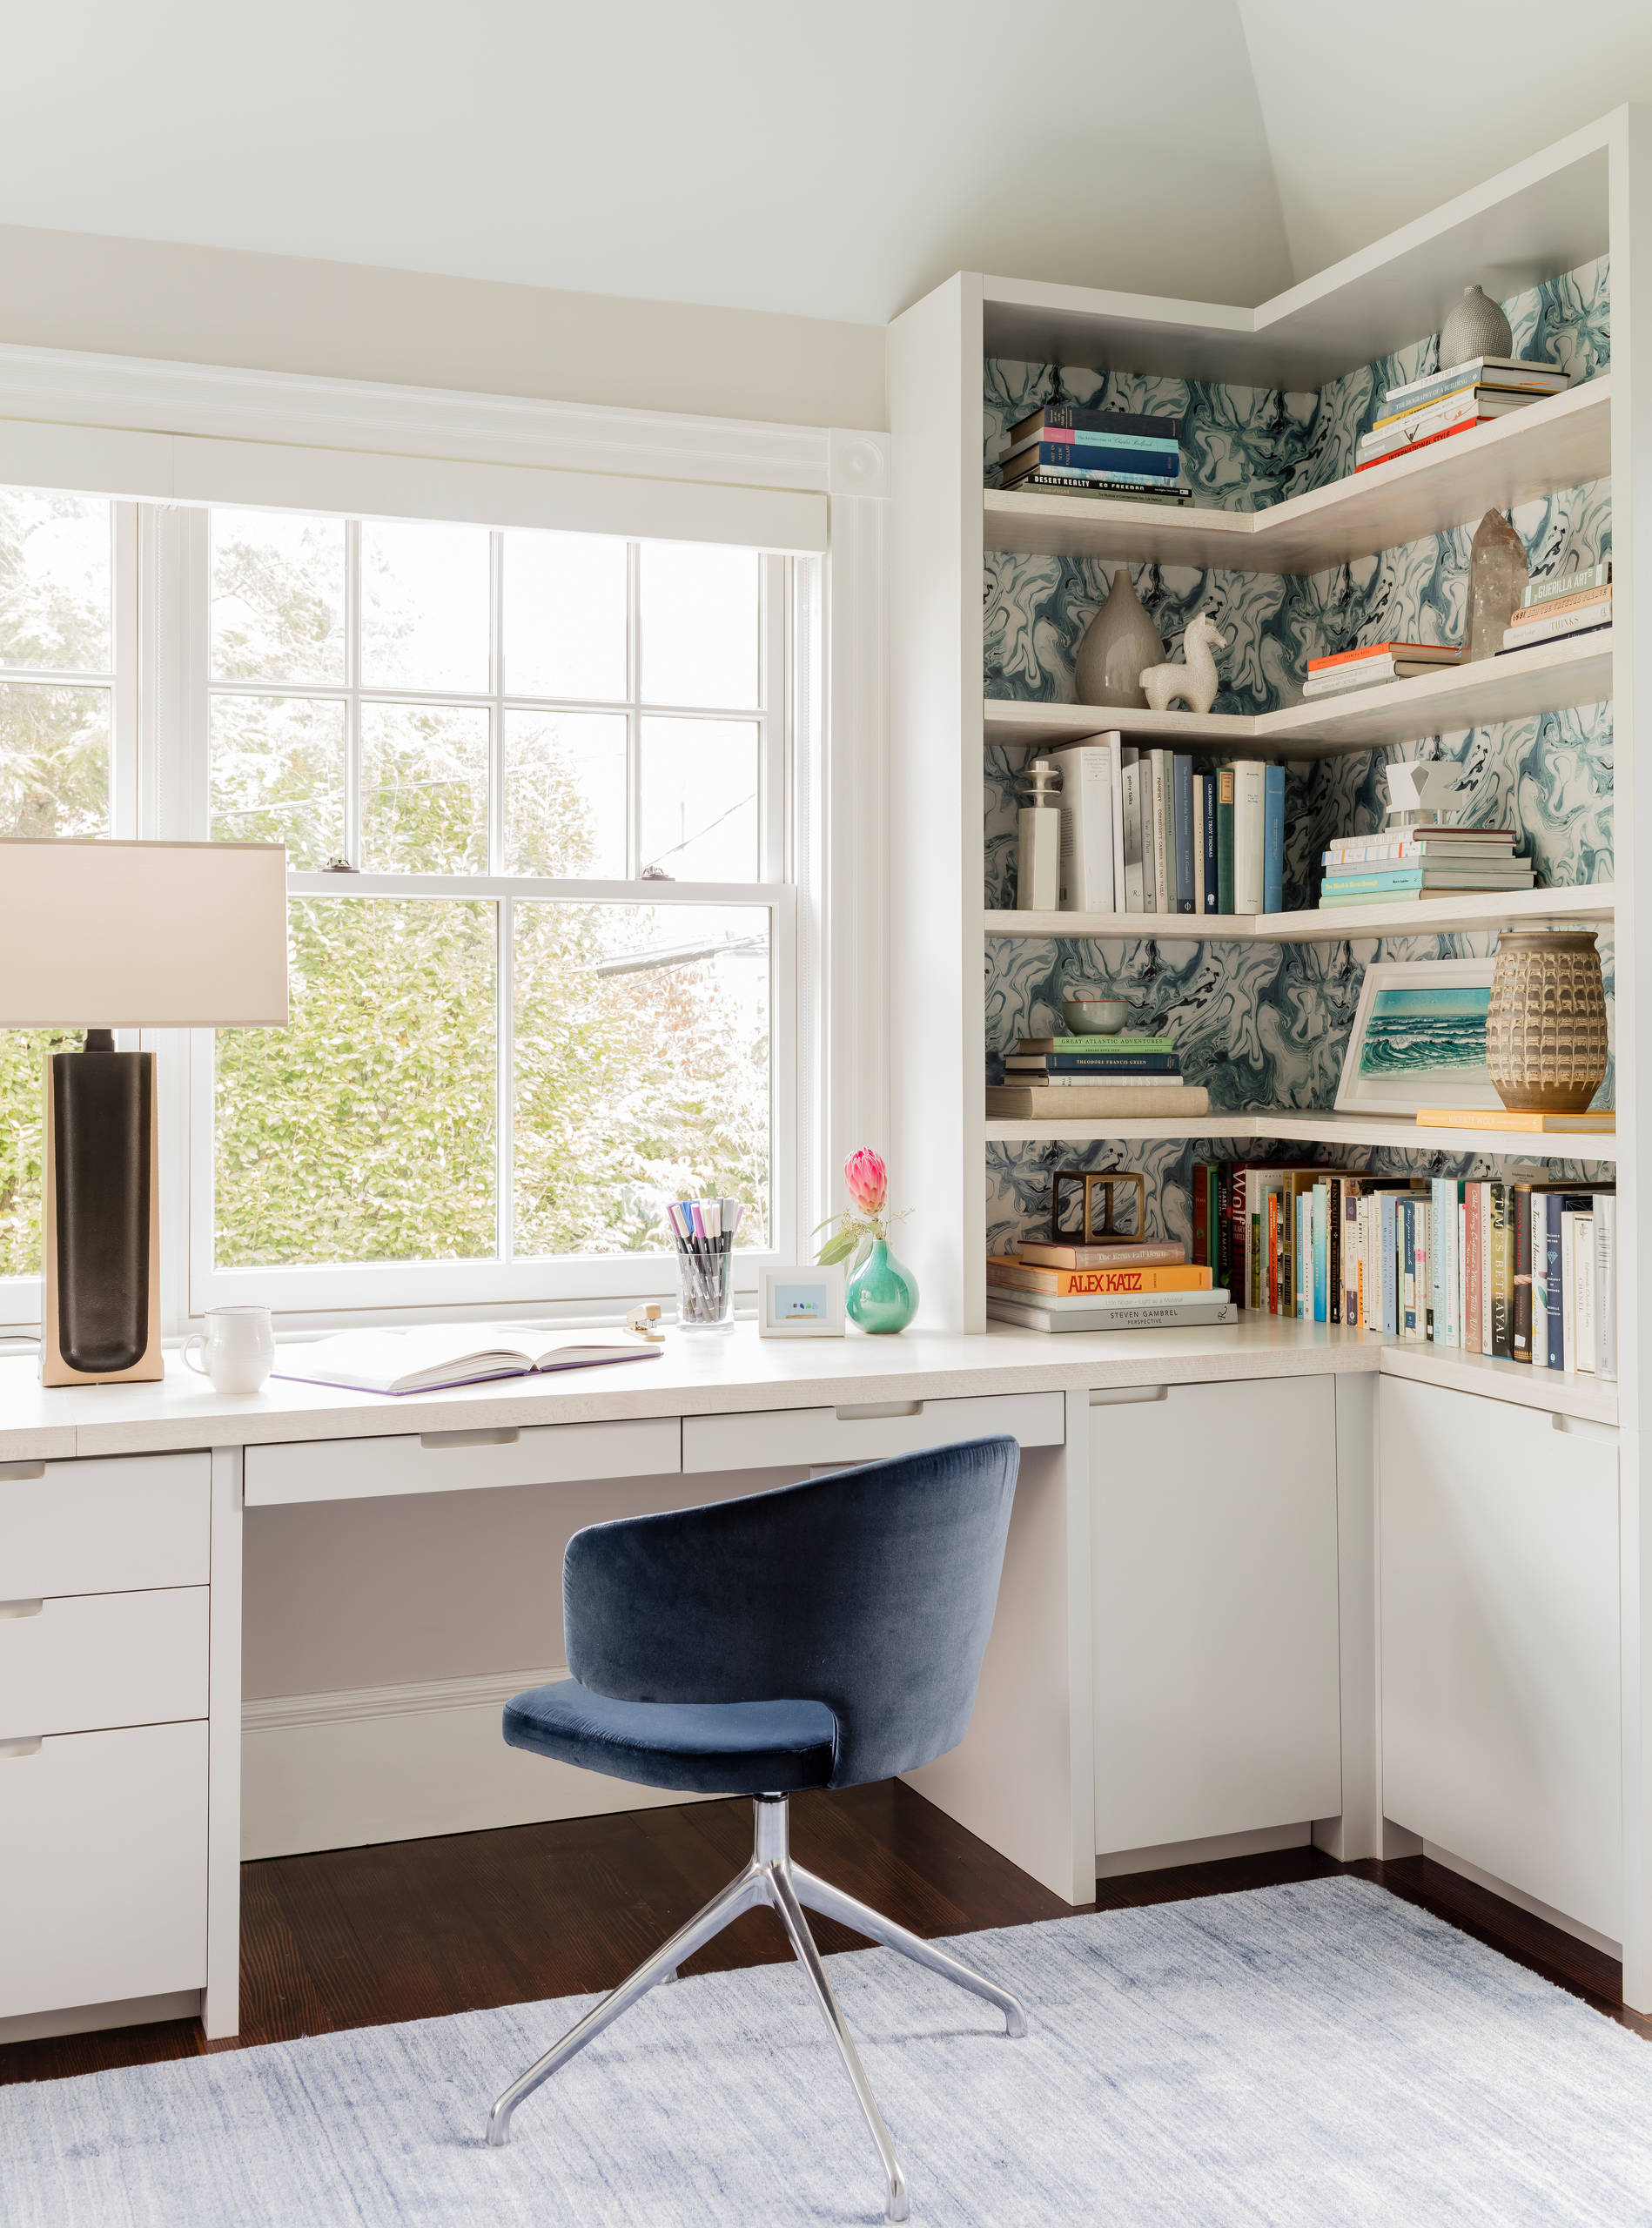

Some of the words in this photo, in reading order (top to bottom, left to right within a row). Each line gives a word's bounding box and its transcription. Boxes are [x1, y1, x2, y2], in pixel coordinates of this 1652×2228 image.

[1034, 475, 1061, 486] DESERT
[1064, 478, 1090, 487] REALTY
[1537, 578, 1573, 600] GUERILLA
[1574, 571, 1588, 587] ART
[1232, 1170, 1246, 1225] Wolf
[1494, 1198, 1504, 1252] TIME'S
[1068, 1274, 1105, 1293] ALEX
[1105, 1273, 1142, 1292] KATZ
[1142, 1309, 1178, 1318] GAMBREL
[1495, 1259, 1505, 1343] BETRAYAL
